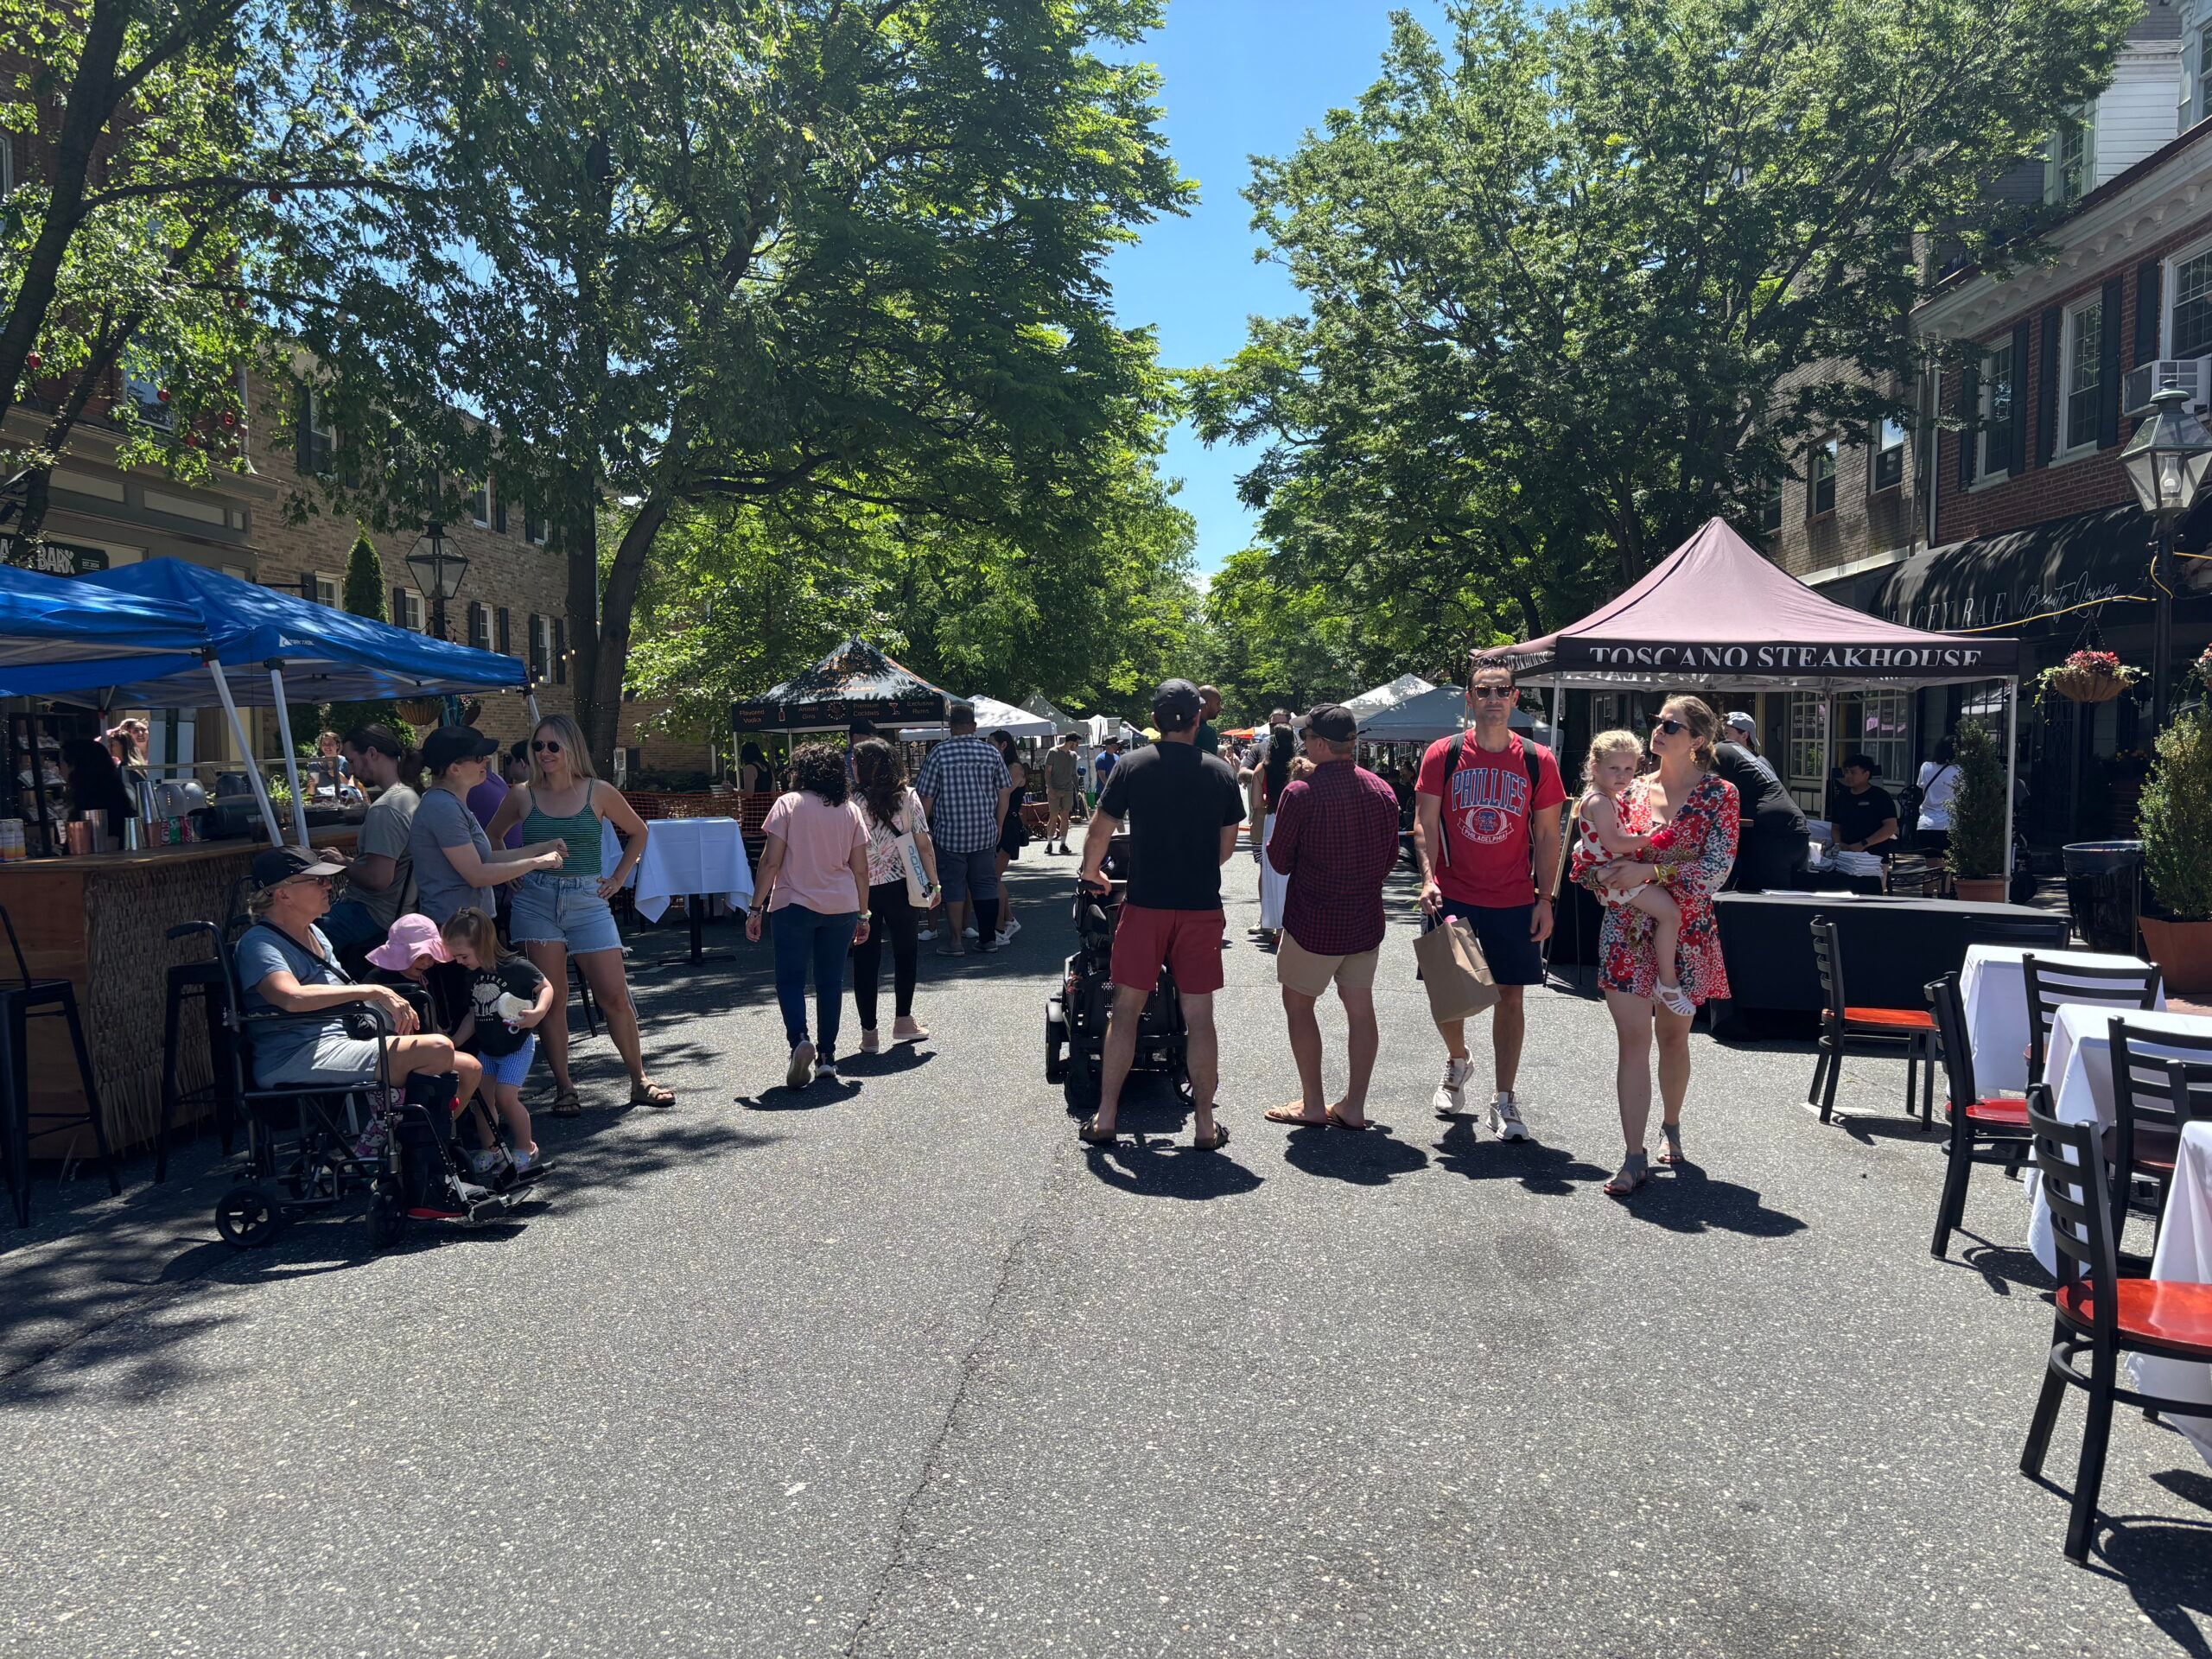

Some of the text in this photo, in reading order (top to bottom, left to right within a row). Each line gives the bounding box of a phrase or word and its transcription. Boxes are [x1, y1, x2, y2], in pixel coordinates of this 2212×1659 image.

[1960, 592, 2006, 628] RAE
[2019, 580, 2076, 628] Beauty
[1589, 646, 1982, 667] TOSCANO STEAKHOUSE
[739, 708, 765, 716] Flavored
[1452, 767, 1527, 817] PHILLIES
[1464, 829, 1505, 842] PHILADELPHIA
